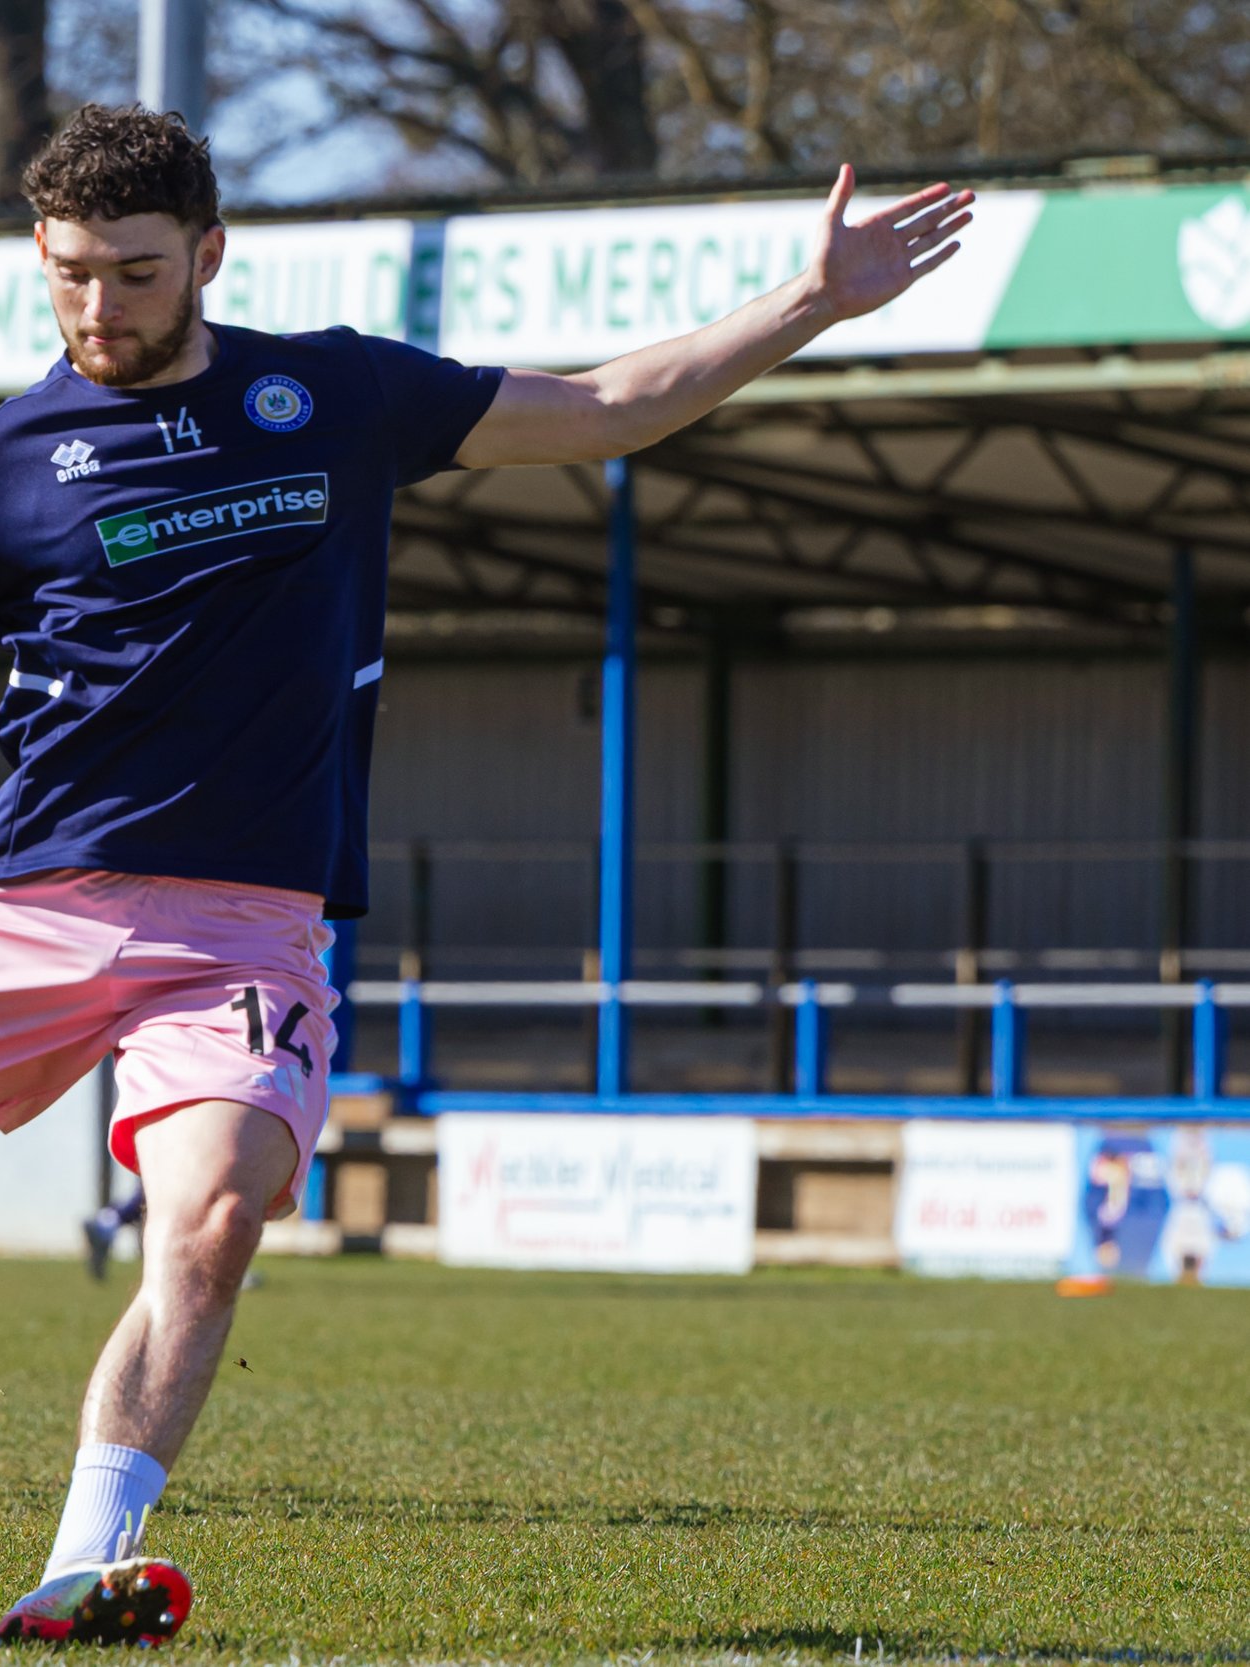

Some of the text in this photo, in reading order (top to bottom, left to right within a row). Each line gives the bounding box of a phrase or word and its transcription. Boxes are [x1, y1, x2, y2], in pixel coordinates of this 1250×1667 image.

[224, 243, 522, 337] BUILDERS
[155, 406, 202, 454] 14
[113, 487, 325, 547] enterprise
[230, 985, 314, 1079] 14
